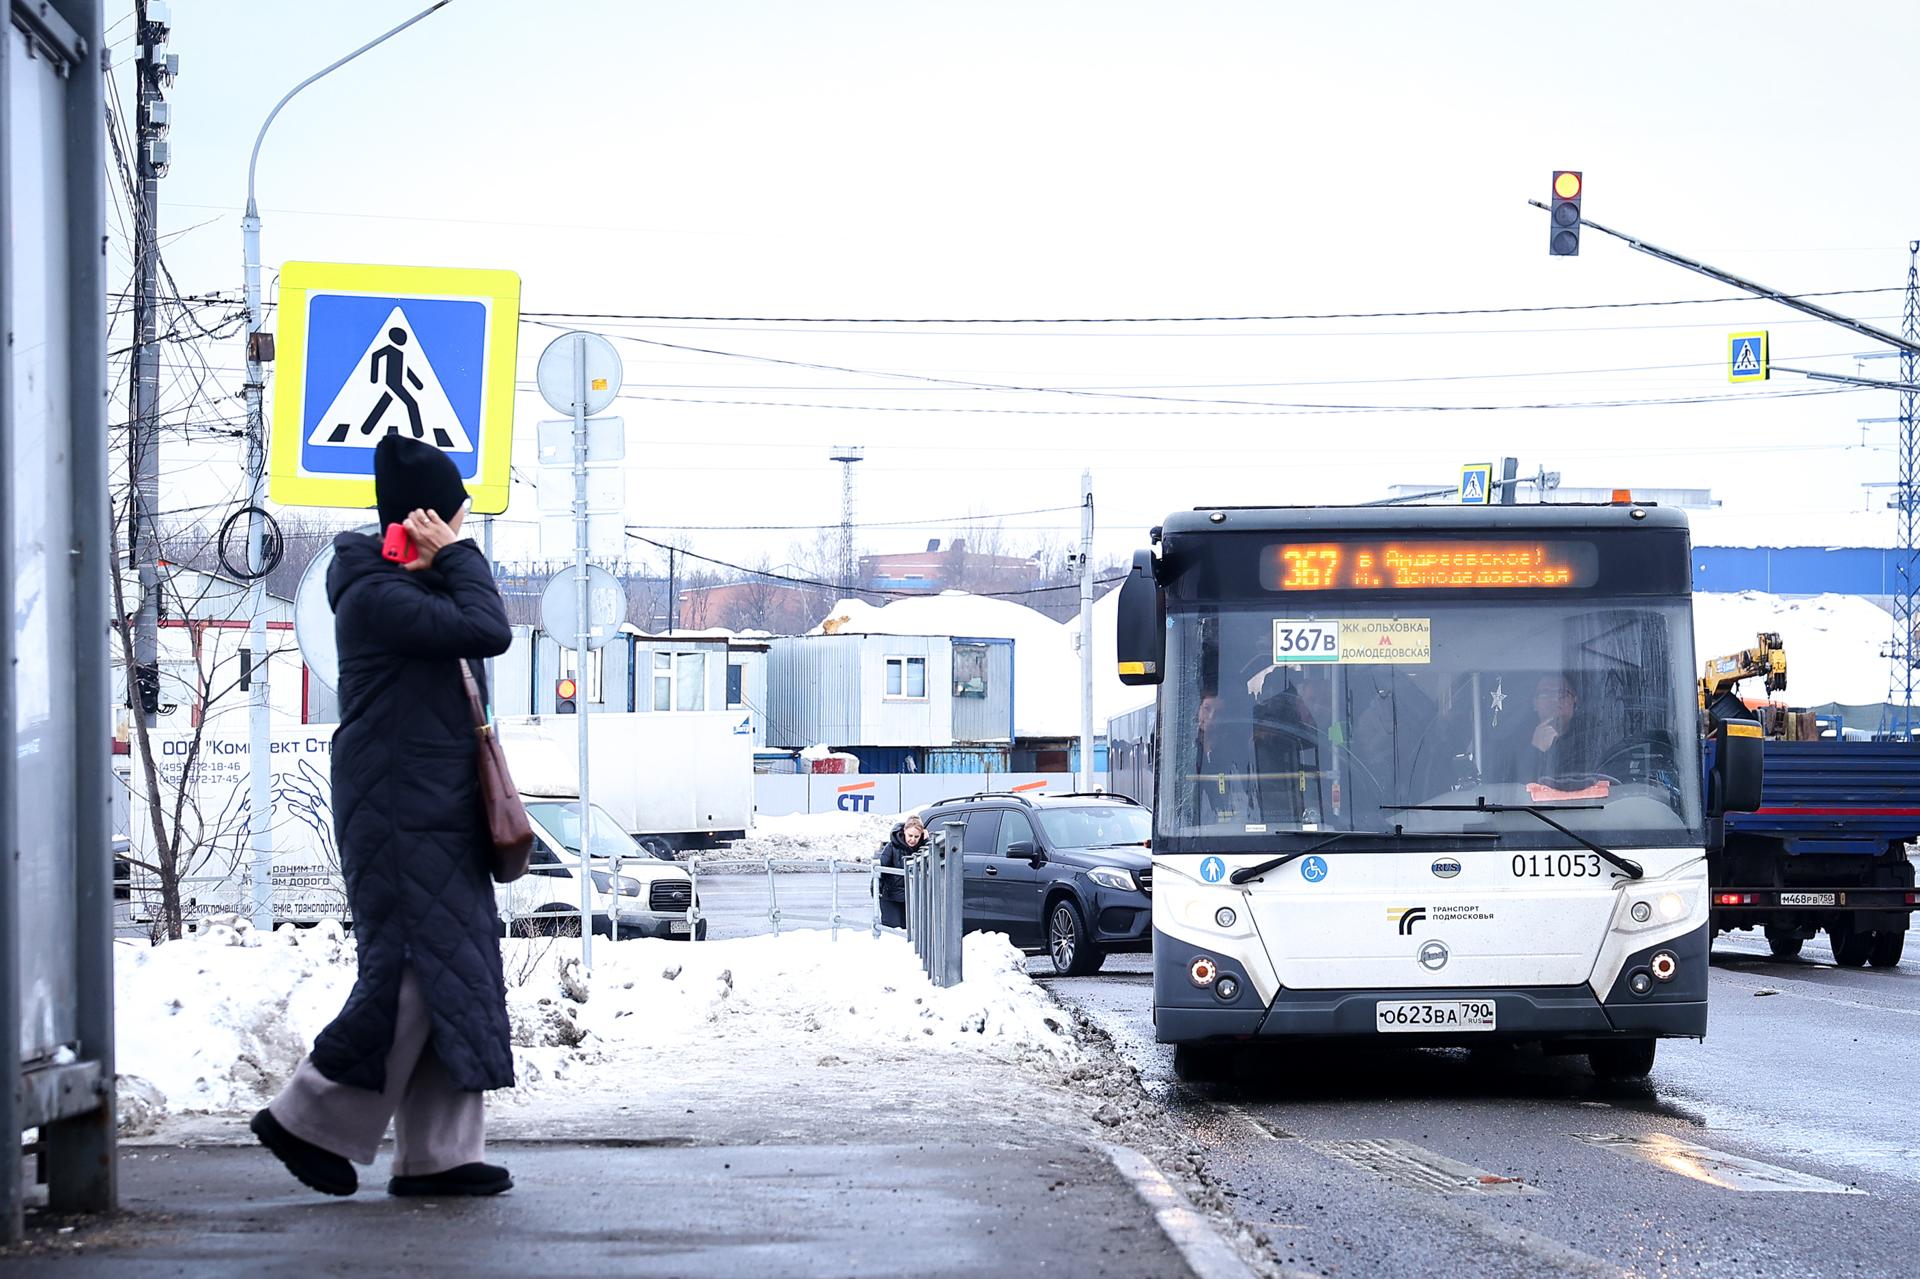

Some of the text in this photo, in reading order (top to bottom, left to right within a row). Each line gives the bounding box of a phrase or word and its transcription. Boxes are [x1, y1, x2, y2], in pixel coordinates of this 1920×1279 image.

[1284, 550, 1337, 586] 367
[1342, 622, 1429, 633] ЖК «ОЛЬХОВКА»
[1341, 647, 1429, 659] ДОМОДЕДОВСКАЯ
[837, 793, 875, 813] СТГ
[1435, 863, 1458, 872] RUS
[1511, 854, 1601, 878] 011053
[290, 877, 330, 888] дорого
[1433, 905, 1479, 913] ТРАНСПОРТ
[1433, 913, 1494, 921] ПОДМОСКОВЬЯ
[1384, 1003, 1489, 1024] О623ВА 790
